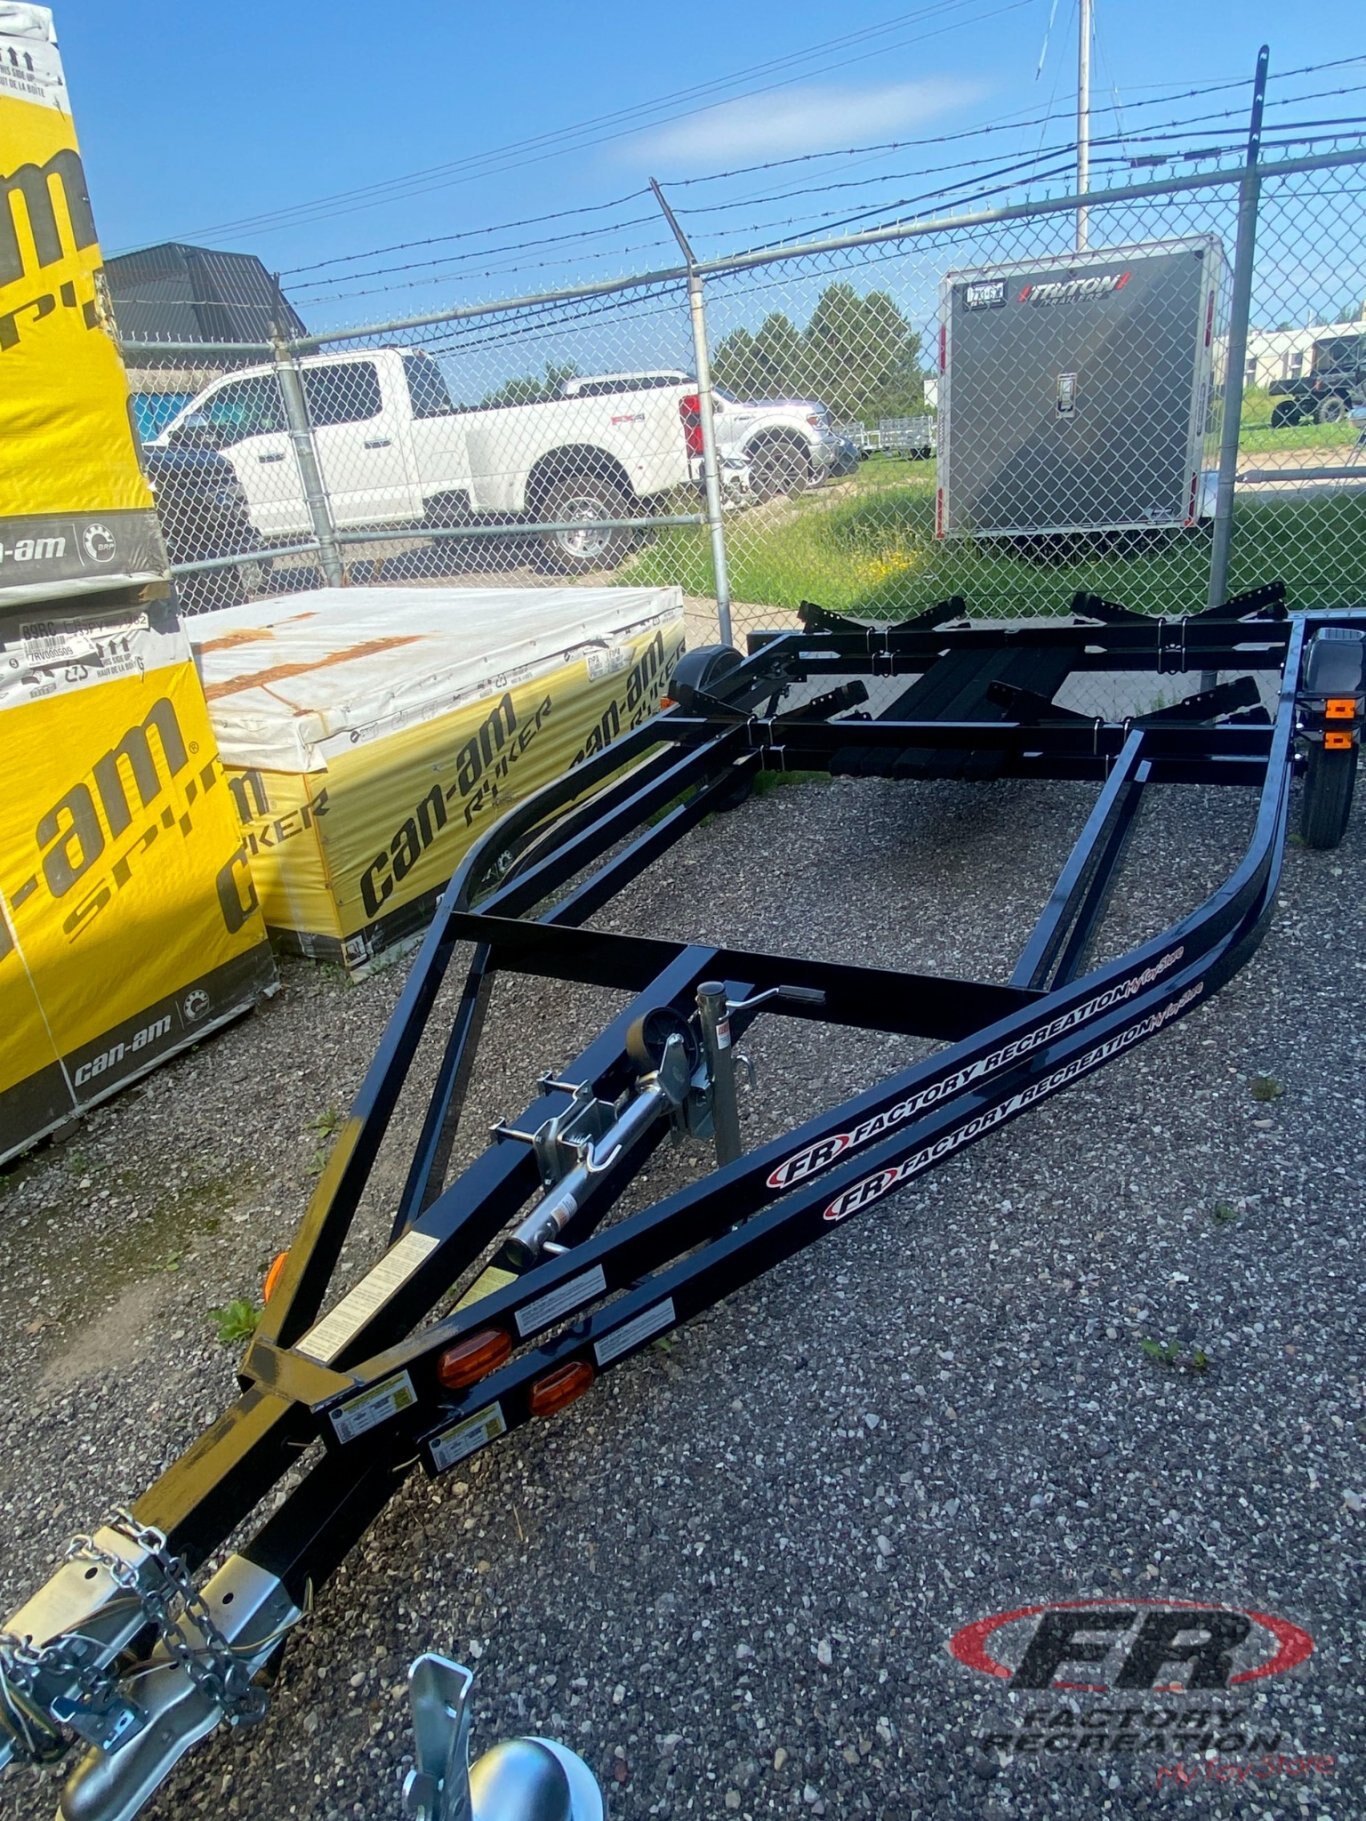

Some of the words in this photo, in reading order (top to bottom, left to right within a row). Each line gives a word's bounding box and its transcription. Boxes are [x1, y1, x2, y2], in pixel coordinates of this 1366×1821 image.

[9, 79, 17, 89] DE
[18, 82, 26, 91] LA
[27, 83, 46, 98] BOÎTE
[12, 68, 26, 80] SIDE
[26, 73, 35, 82] UP
[1029, 274, 1122, 302] TRITON
[1040, 293, 1103, 308] TRAILERS
[97, 668, 111, 679] HAUT
[112, 667, 118, 675] DE
[119, 664, 125, 673] LA
[113, 655, 123, 665] SIDE
[124, 653, 131, 662] UP
[465, 694, 552, 828] RYKER
[360, 692, 518, 918] can-am
[74, 1014, 172, 1088] can-am
[784, 1141, 838, 1186] FR
[852, 1064, 978, 1147] FACTORY
[984, 981, 1130, 1073] RECREATION
[838, 1171, 889, 1218] FR
[897, 1096, 1021, 1177] FACTORY
[1018, 1017, 1153, 1107] RECREATION
